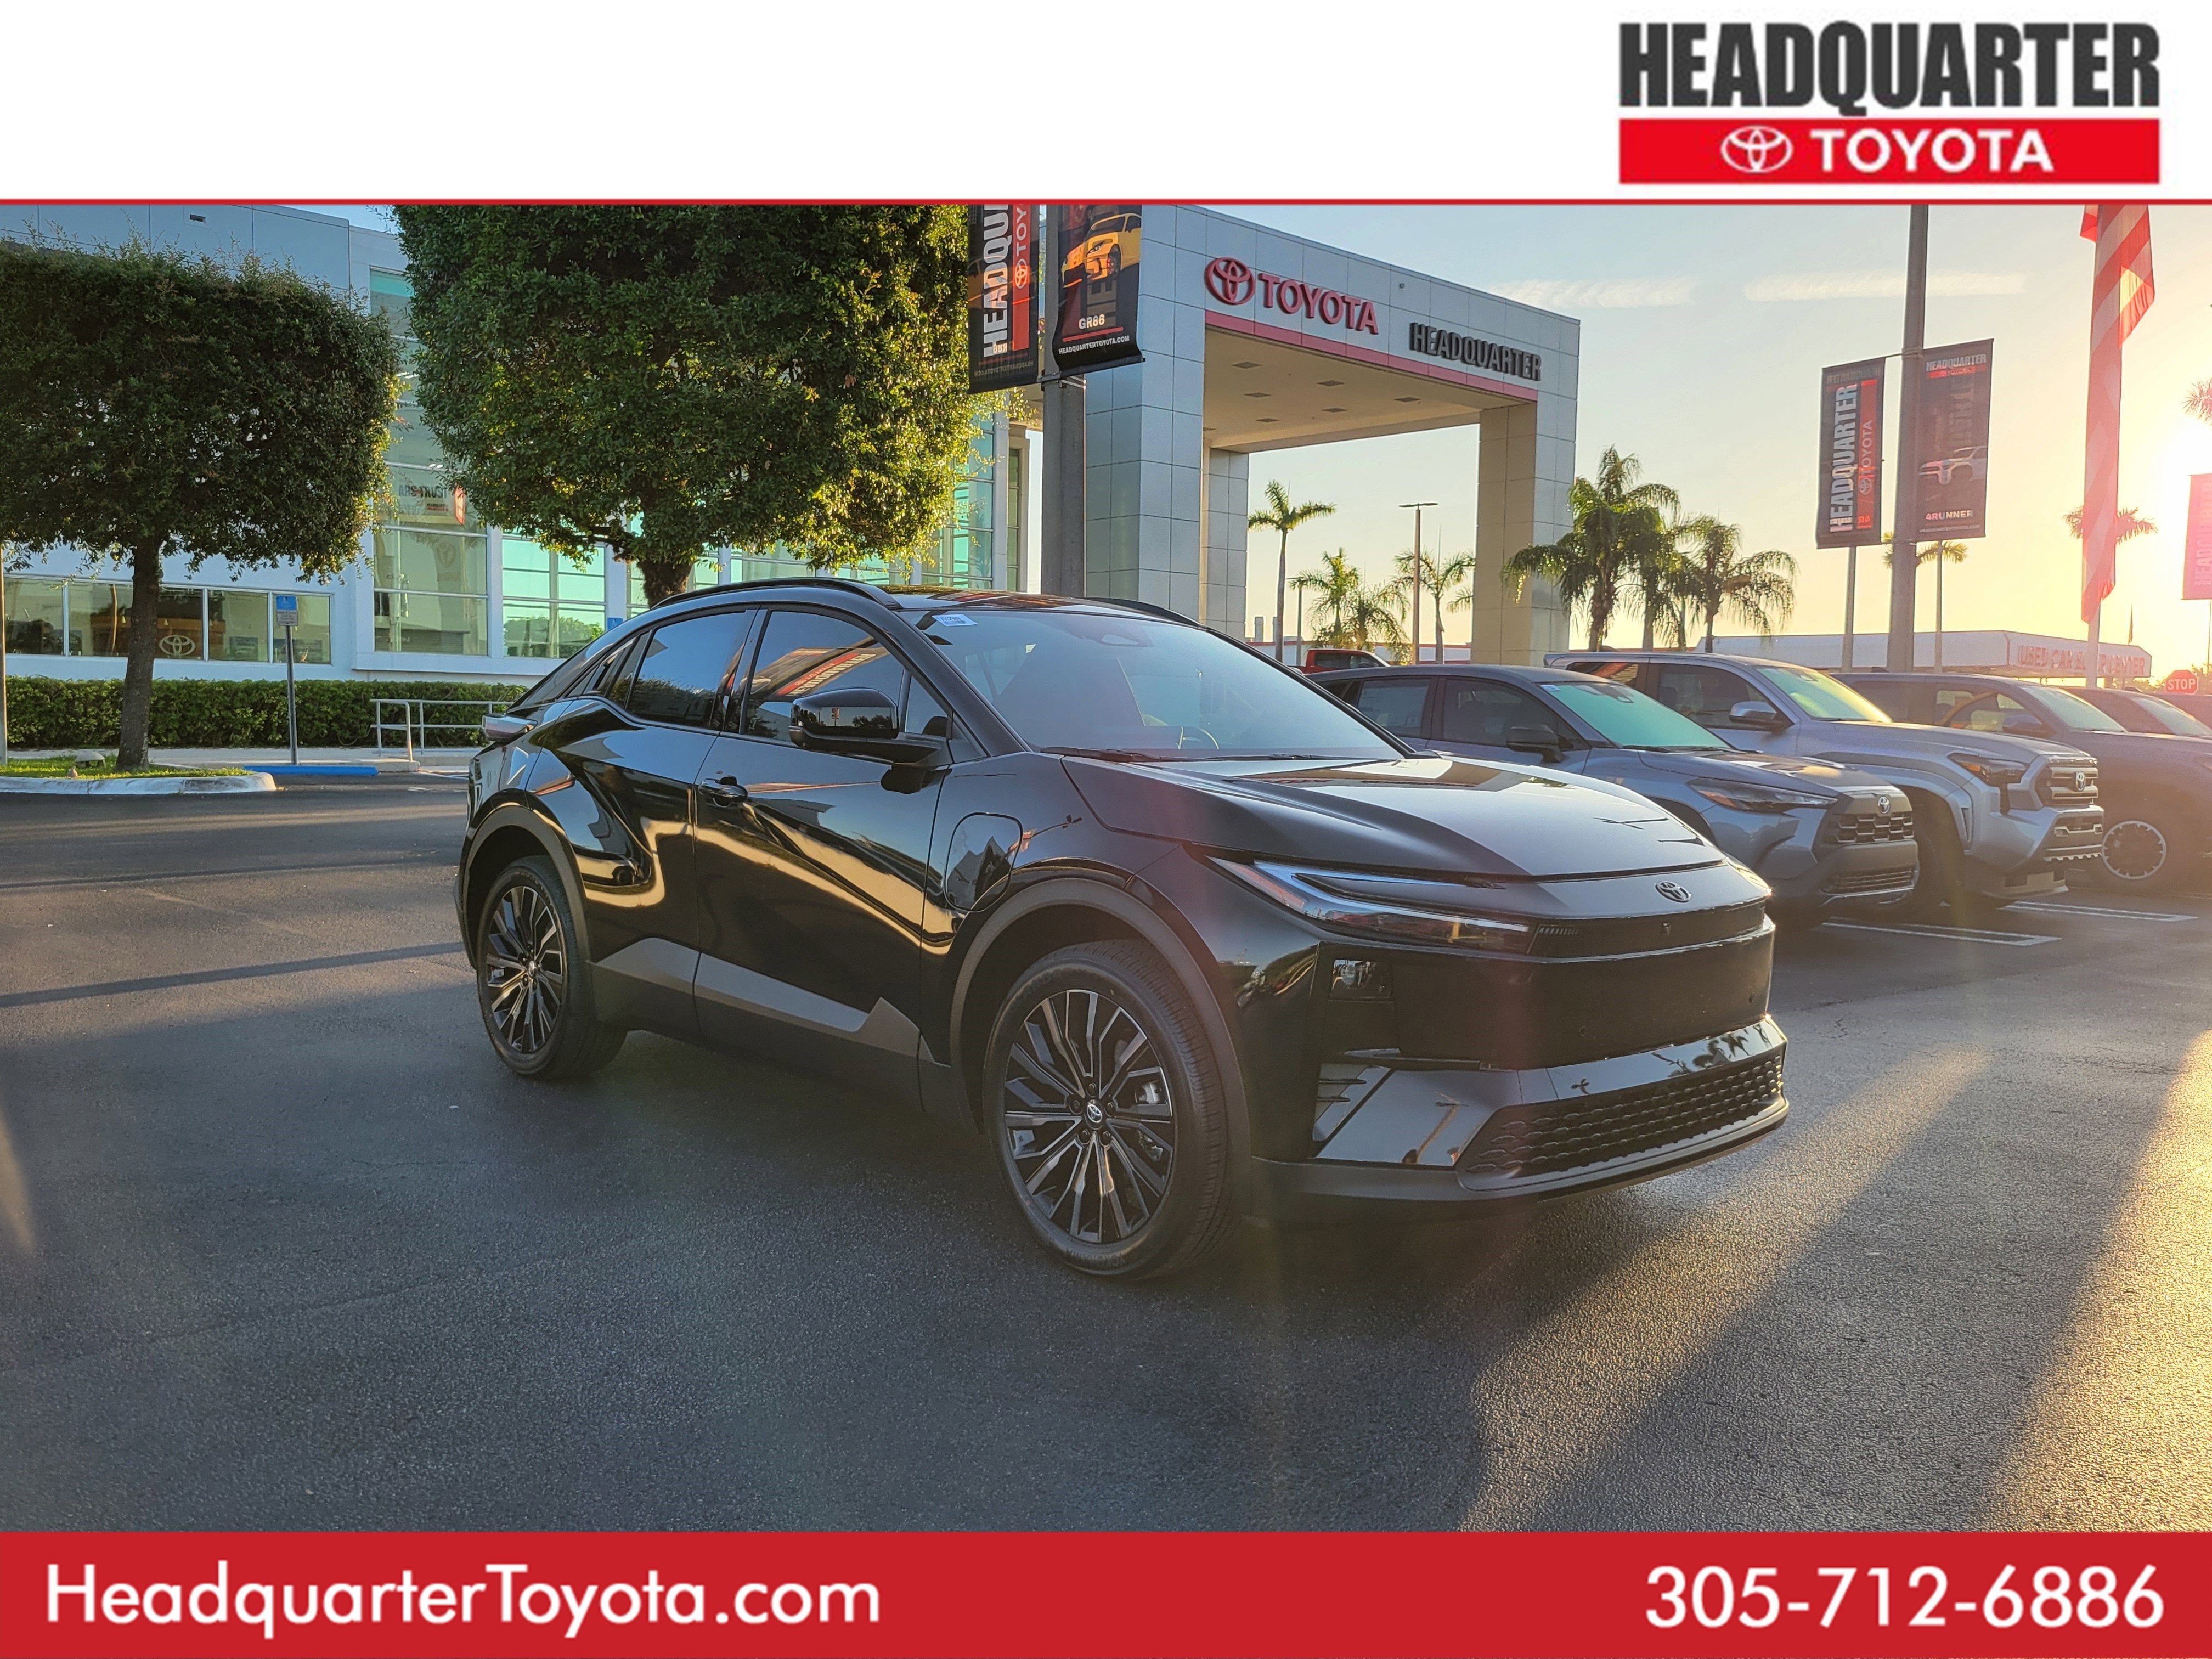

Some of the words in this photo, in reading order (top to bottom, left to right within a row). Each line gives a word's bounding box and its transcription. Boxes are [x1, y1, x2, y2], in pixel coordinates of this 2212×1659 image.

[1017, 204, 1027, 257] TOY
[984, 205, 1012, 357] HEADQU
[1079, 314, 1105, 329] GR86
[1259, 273, 1379, 335] TOYOTA
[1059, 335, 1130, 354] HEADQUARTERTOYOTA.COM
[1409, 322, 1542, 381] HEADQUARTER
[1926, 354, 1986, 371] HEADQUARTER
[1830, 383, 1858, 532] HEADQUARTER
[1862, 420, 1872, 476] TOYOTA
[1925, 510, 1973, 520] 4RUNNER
[2020, 646, 2047, 667] USED
[2052, 649, 2073, 670] CAR
[2166, 678, 2196, 690] STOP
